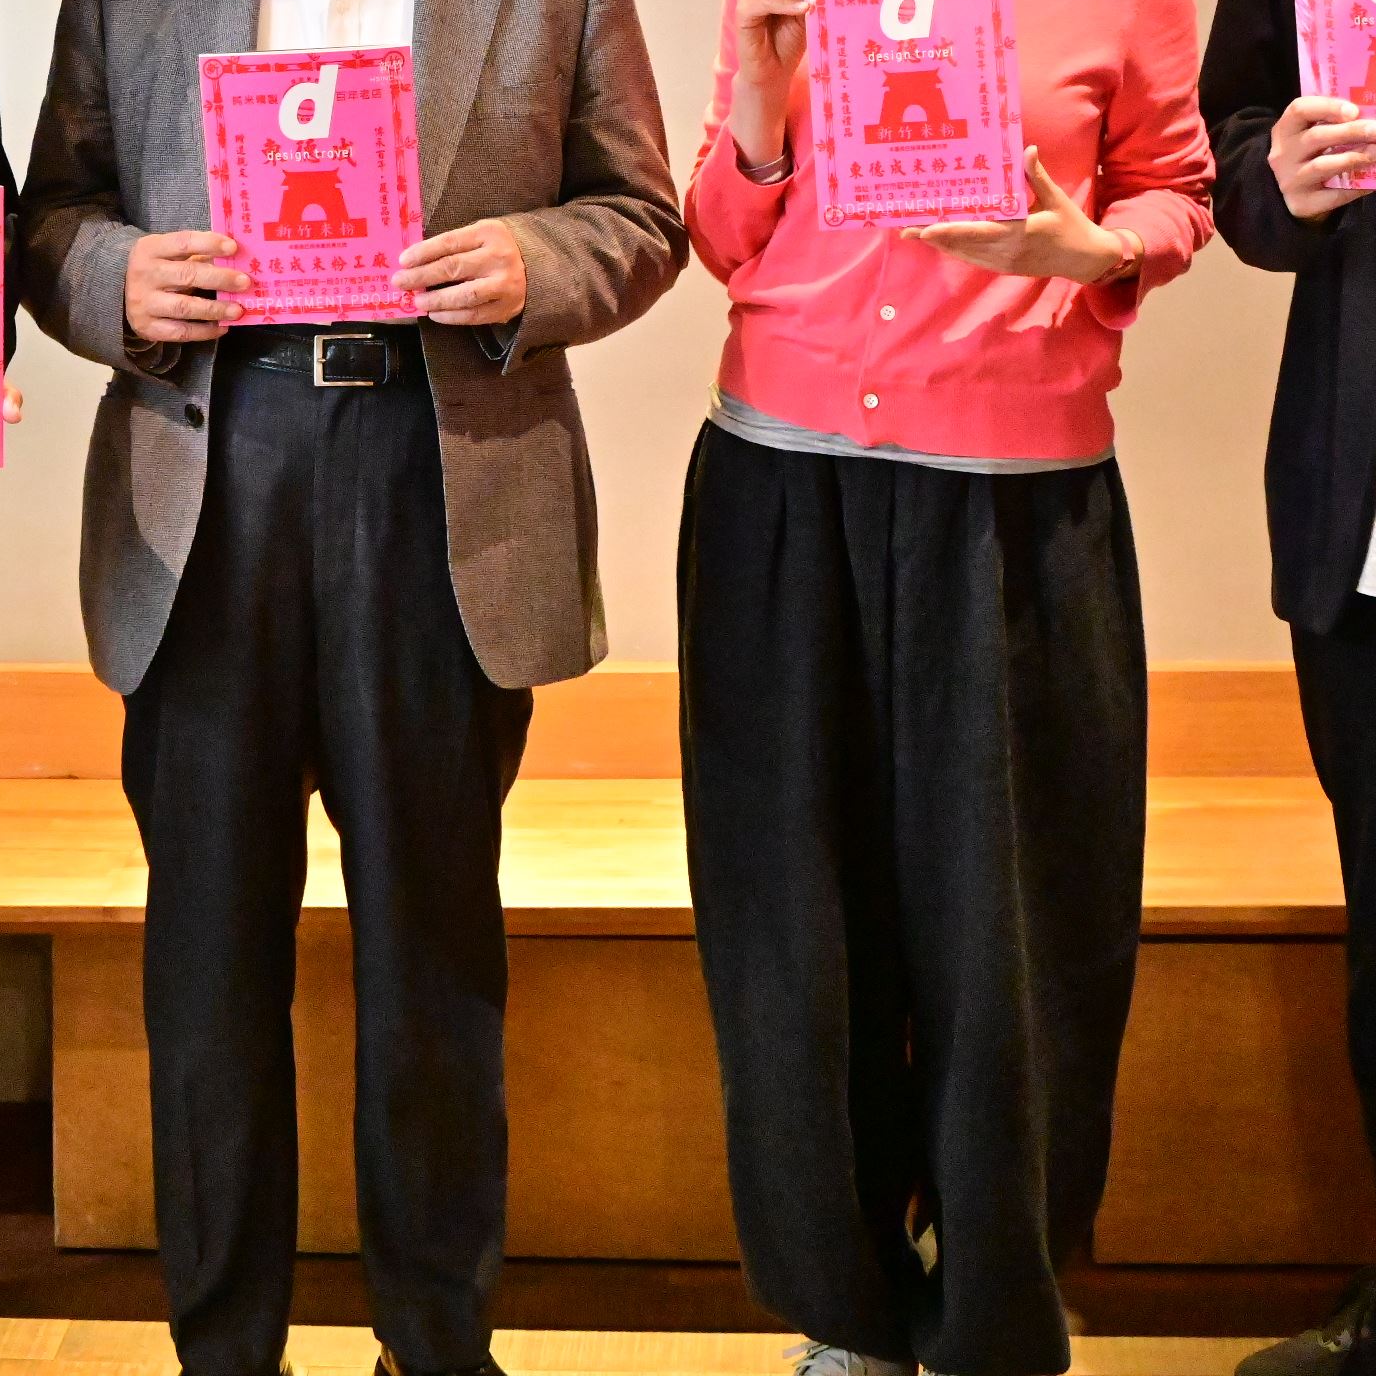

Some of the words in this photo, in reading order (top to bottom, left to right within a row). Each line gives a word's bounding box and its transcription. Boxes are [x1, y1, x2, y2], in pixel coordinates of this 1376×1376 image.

[869, 48, 911, 63] design
[915, 46, 953, 59] travel
[278, 65, 338, 140] d
[878, 124, 955, 140] 新竹米粉
[268, 149, 310, 163] design
[315, 146, 352, 159] travel
[276, 223, 355, 238] 新竹米粉
[241, 295, 344, 310] DEPARTMENT
[351, 291, 413, 305] PROJEC
